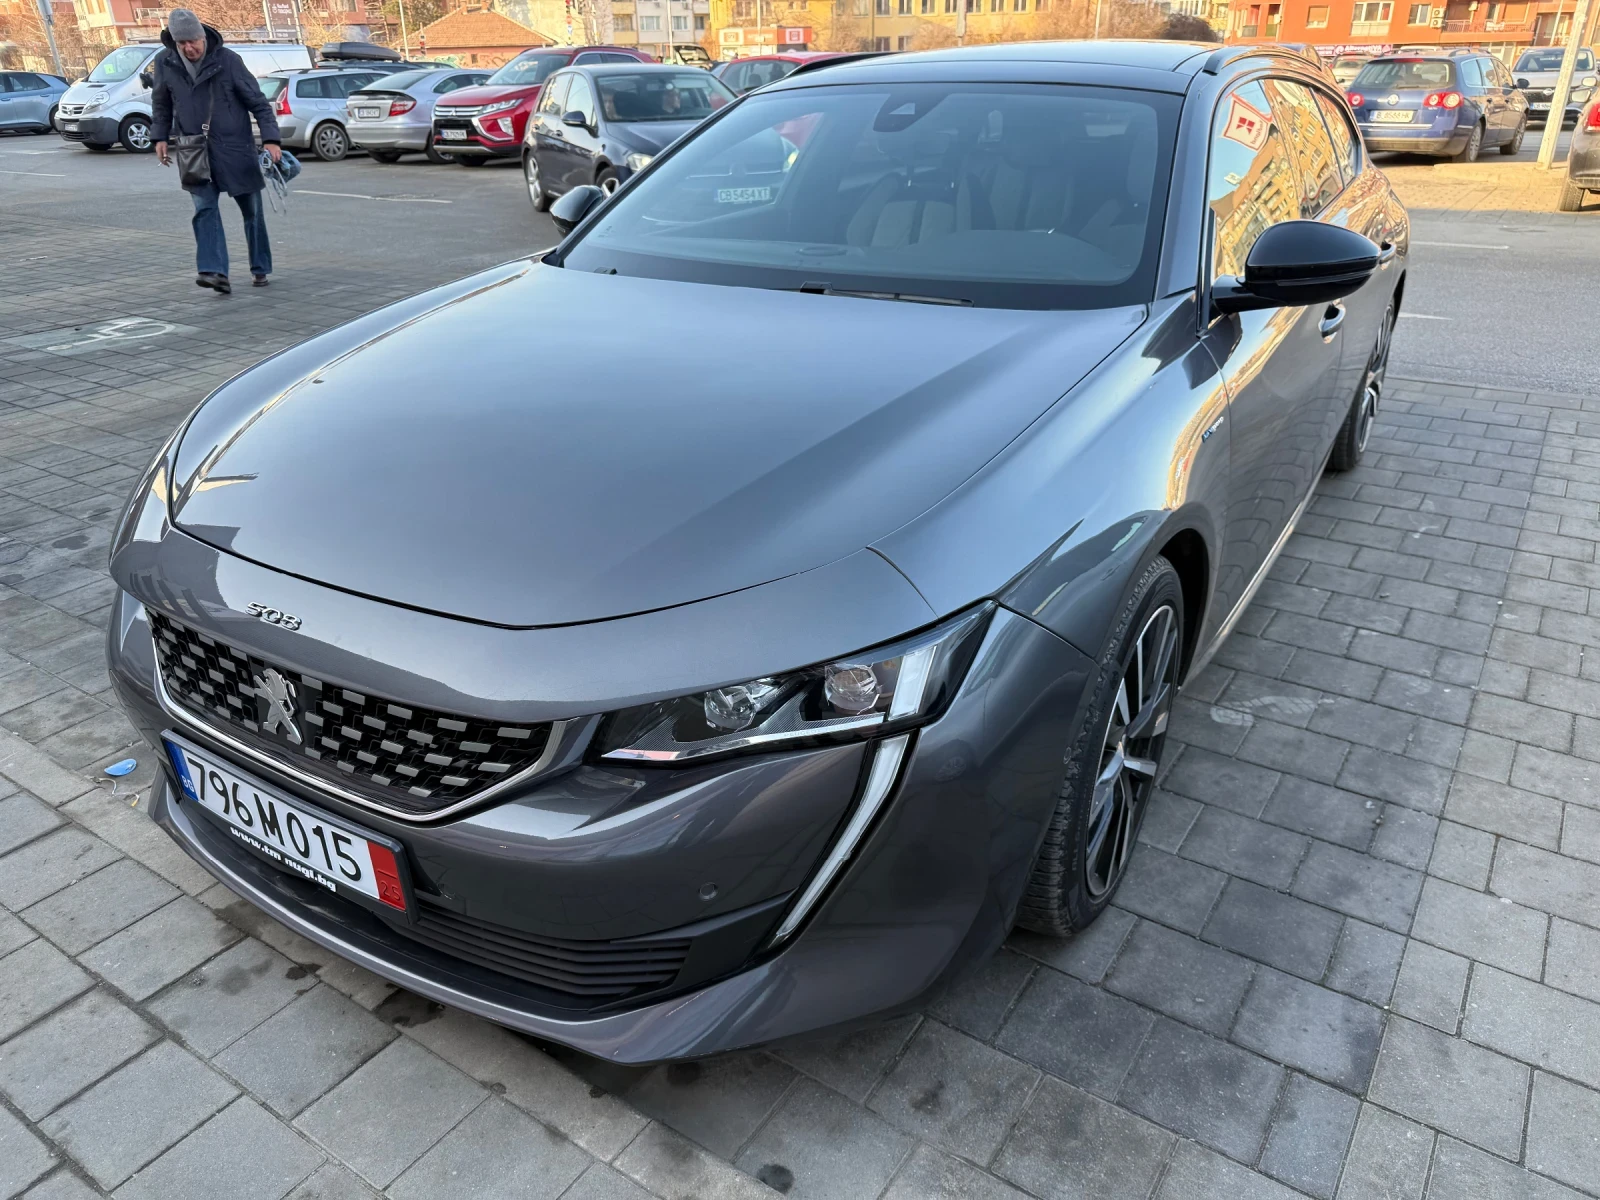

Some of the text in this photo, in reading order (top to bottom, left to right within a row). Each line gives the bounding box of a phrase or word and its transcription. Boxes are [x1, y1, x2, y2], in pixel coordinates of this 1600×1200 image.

[245, 601, 302, 631] 508
[180, 774, 195, 793] BG
[380, 880, 401, 901] 25
